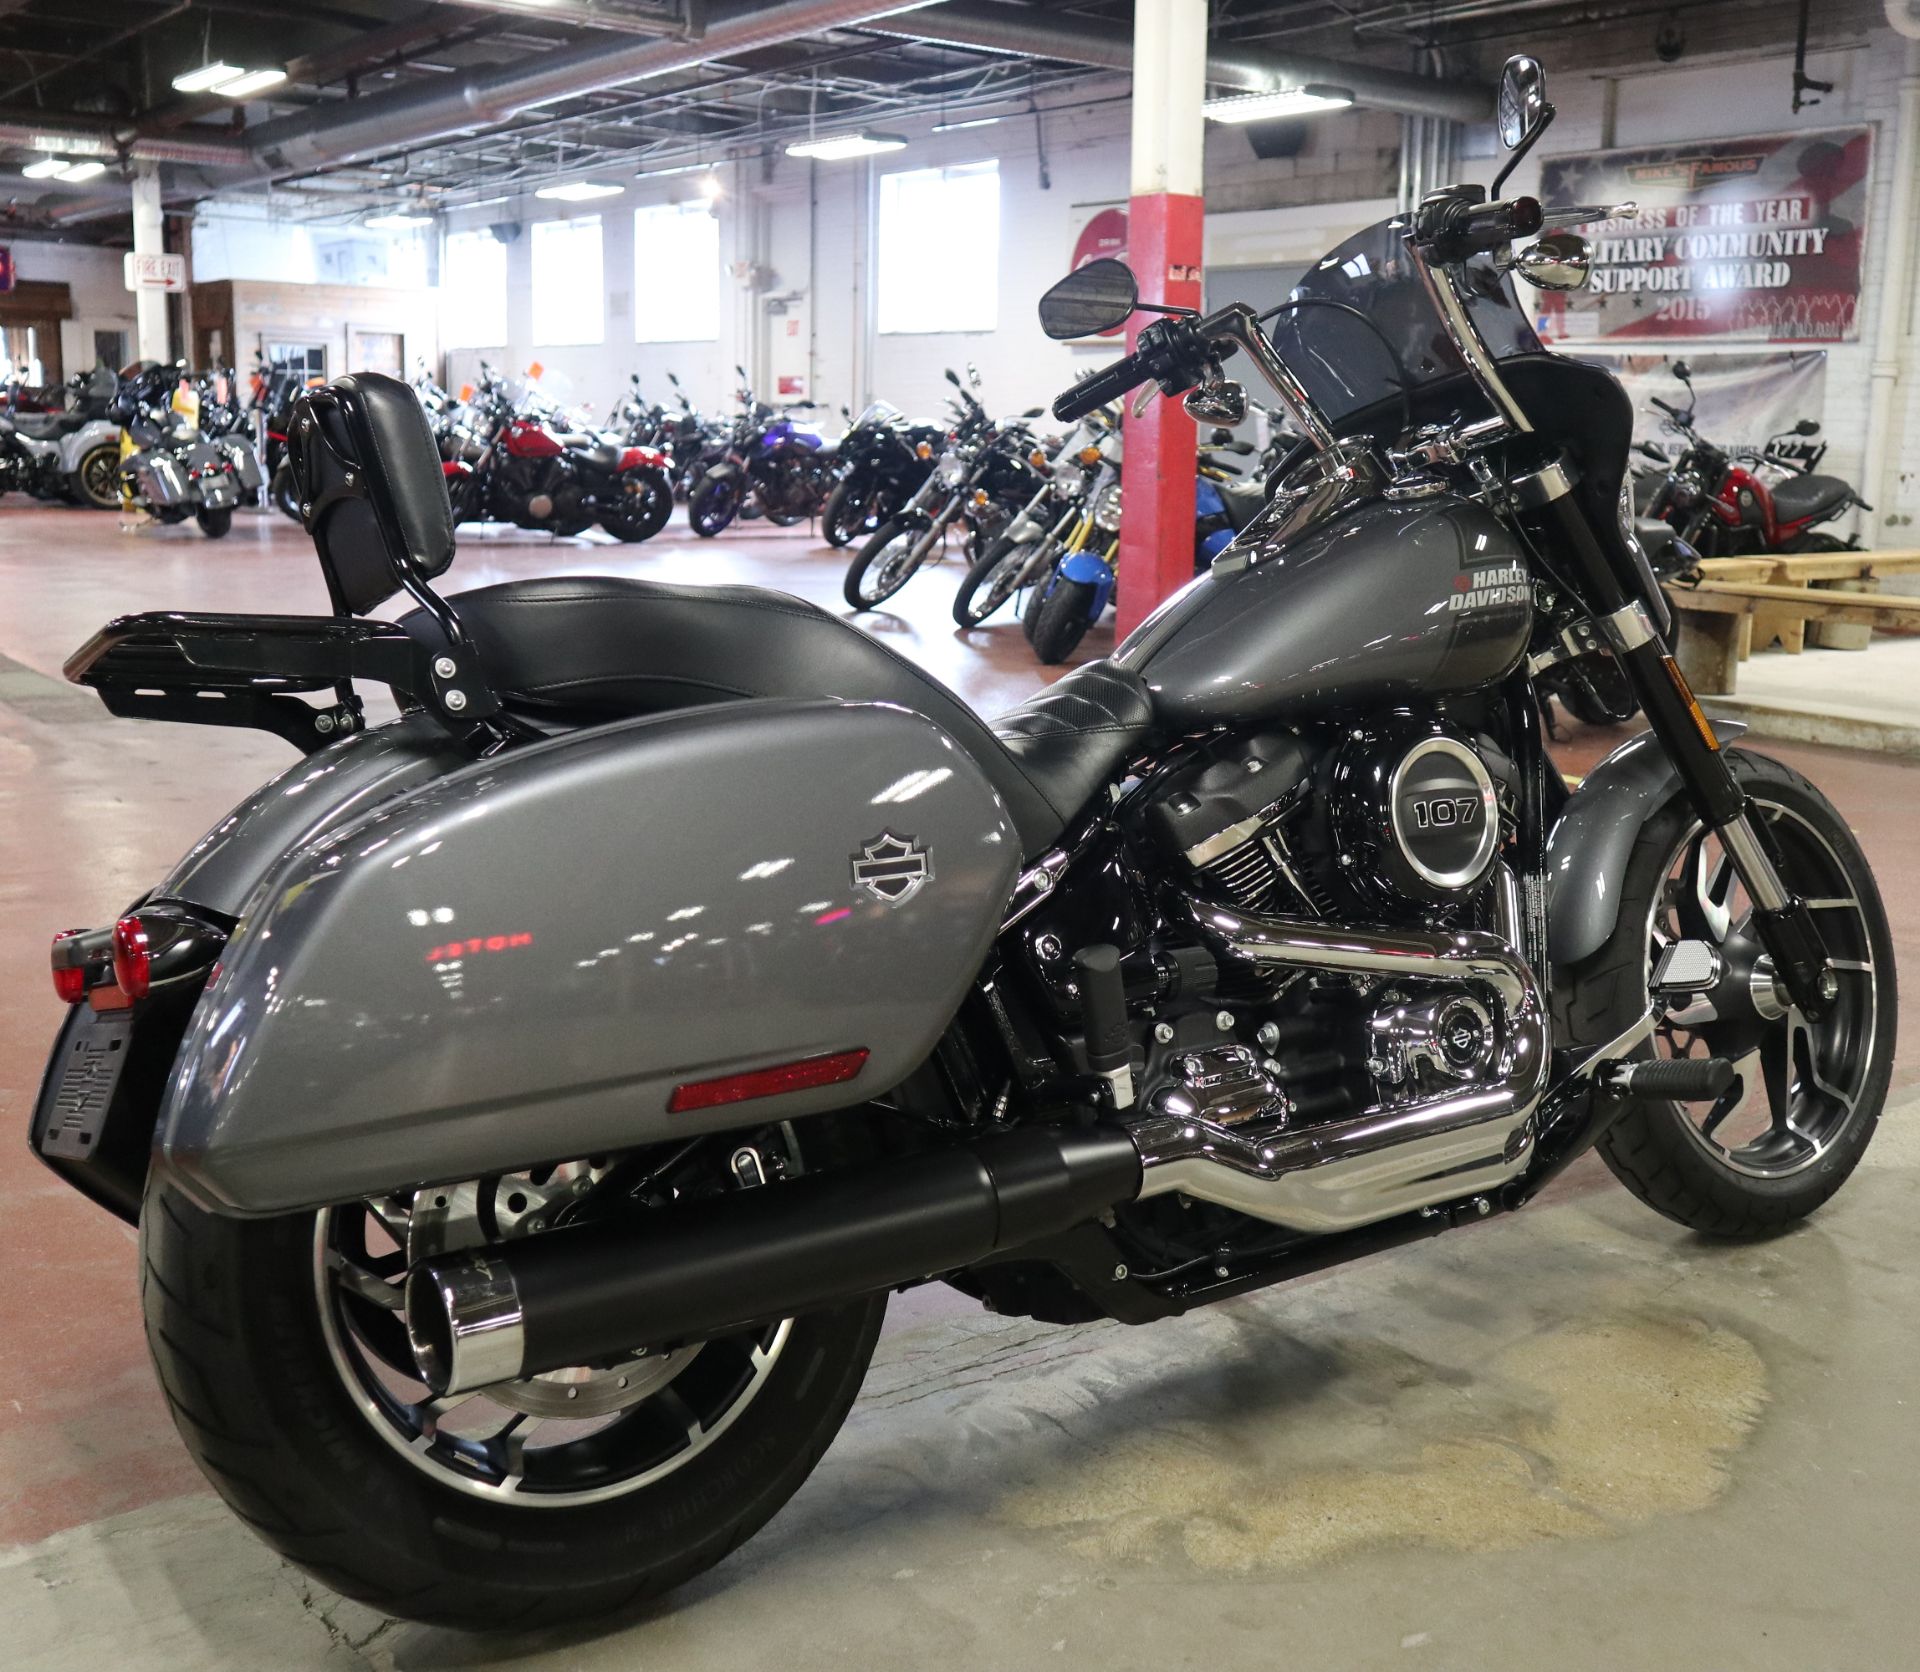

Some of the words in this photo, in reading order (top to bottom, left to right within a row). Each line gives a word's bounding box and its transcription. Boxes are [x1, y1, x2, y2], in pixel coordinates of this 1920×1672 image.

[1675, 206, 1699, 227] OF
[1709, 202, 1744, 225] THE
[1755, 199, 1803, 222] YEAR
[1588, 235, 1668, 265] LITARY
[1674, 228, 1829, 260] COMMUNITY
[1589, 264, 1692, 294] SUPPORT
[1703, 261, 1791, 290] AWARD
[1656, 296, 1711, 321] 2015
[1448, 585, 1531, 611] DAVIDSON
[1413, 796, 1479, 828] 107
